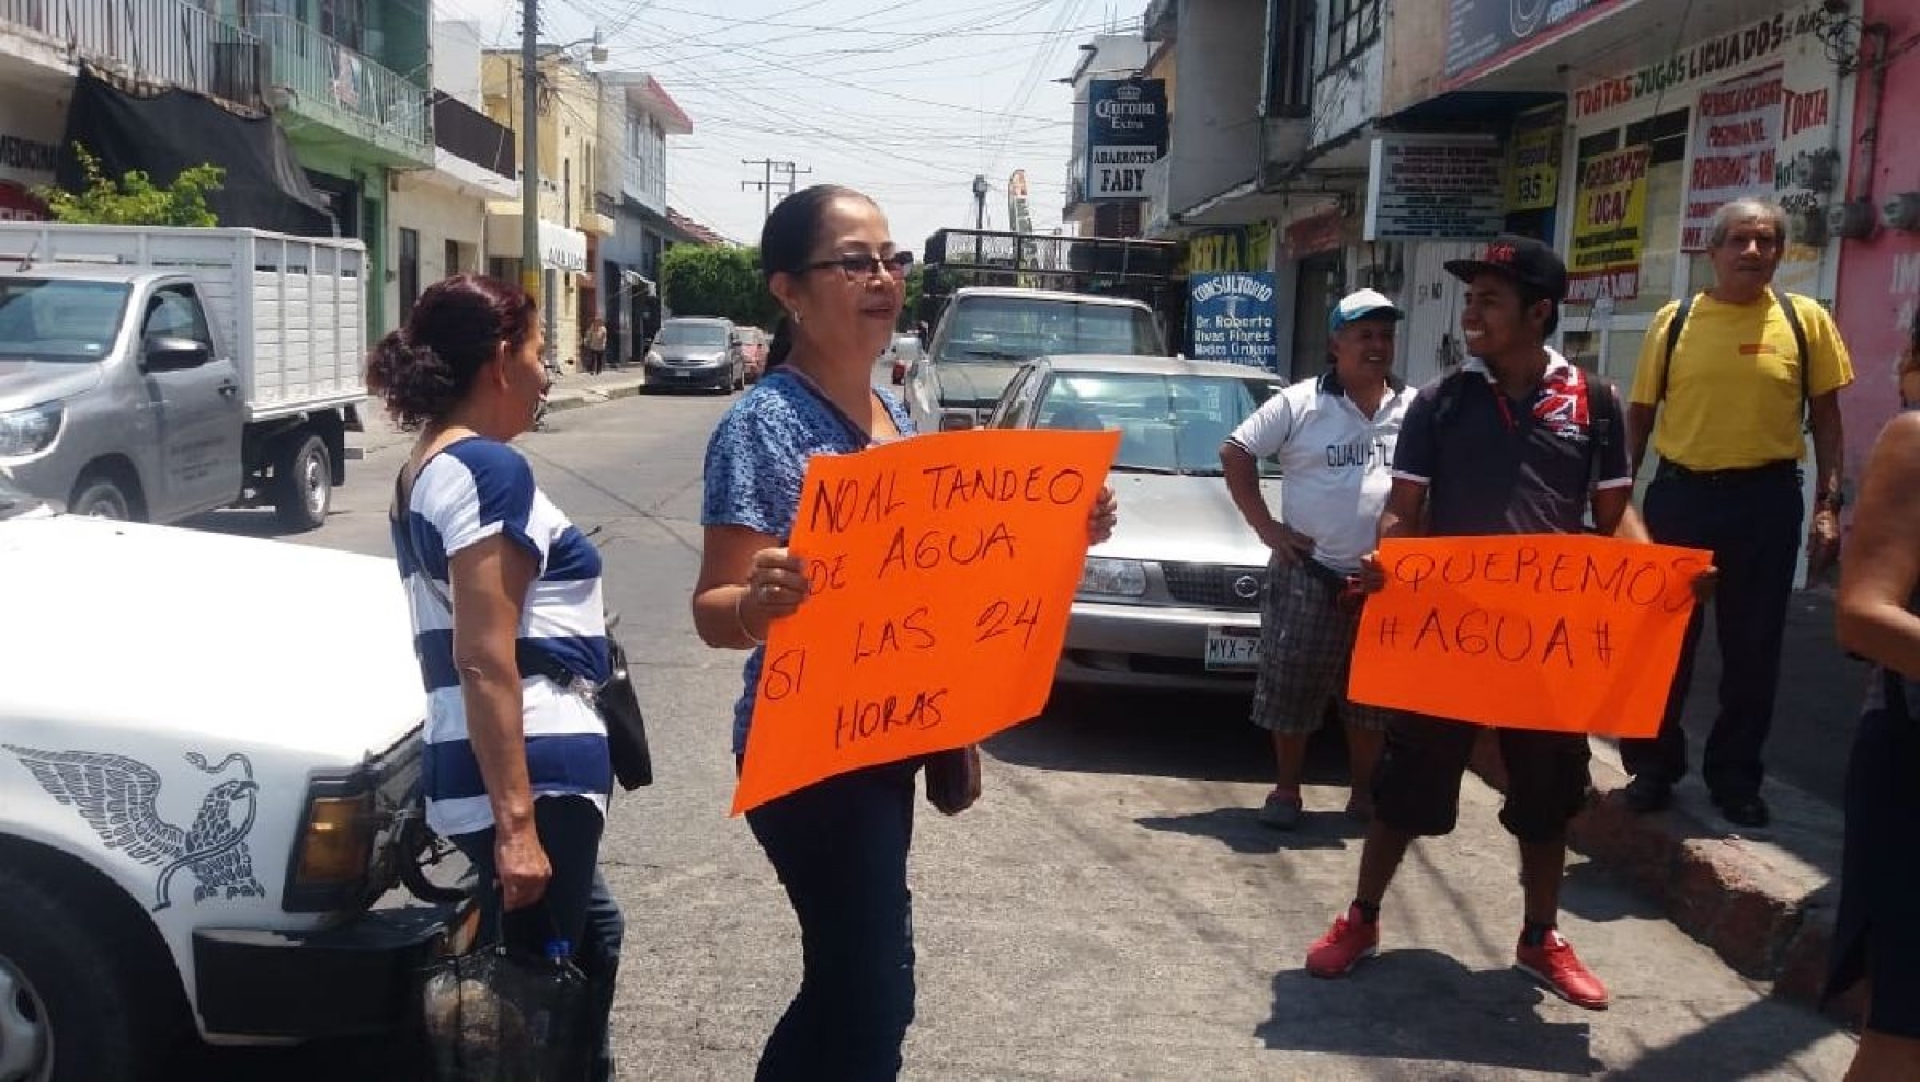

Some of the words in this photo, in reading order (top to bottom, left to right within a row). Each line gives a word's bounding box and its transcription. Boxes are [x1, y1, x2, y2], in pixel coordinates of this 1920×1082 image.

[1575, 75, 1633, 119] TORTAS
[1634, 56, 1685, 98] JUGOS
[1689, 13, 1783, 79] LICUADOS
[1096, 99, 1155, 121] Corona
[1112, 116, 1143, 129] Extra
[1094, 151, 1156, 164] ABARROTES
[1100, 168, 1146, 192] FABY
[1192, 274, 1273, 302] CONSULTORIO
[1196, 315, 1212, 329] Dr.
[1216, 314, 1273, 329] Roberto
[1229, 328, 1271, 342] Flores
[923, 464, 1084, 510] TANDEO
[808, 553, 847, 596] DE
[877, 521, 1016, 580] AGUA
[1395, 546, 1703, 614] QUEREMOS
[764, 648, 806, 701] SI
[853, 607, 936, 665] LAS
[974, 597, 1043, 651] 24
[834, 687, 948, 751] HORAS
